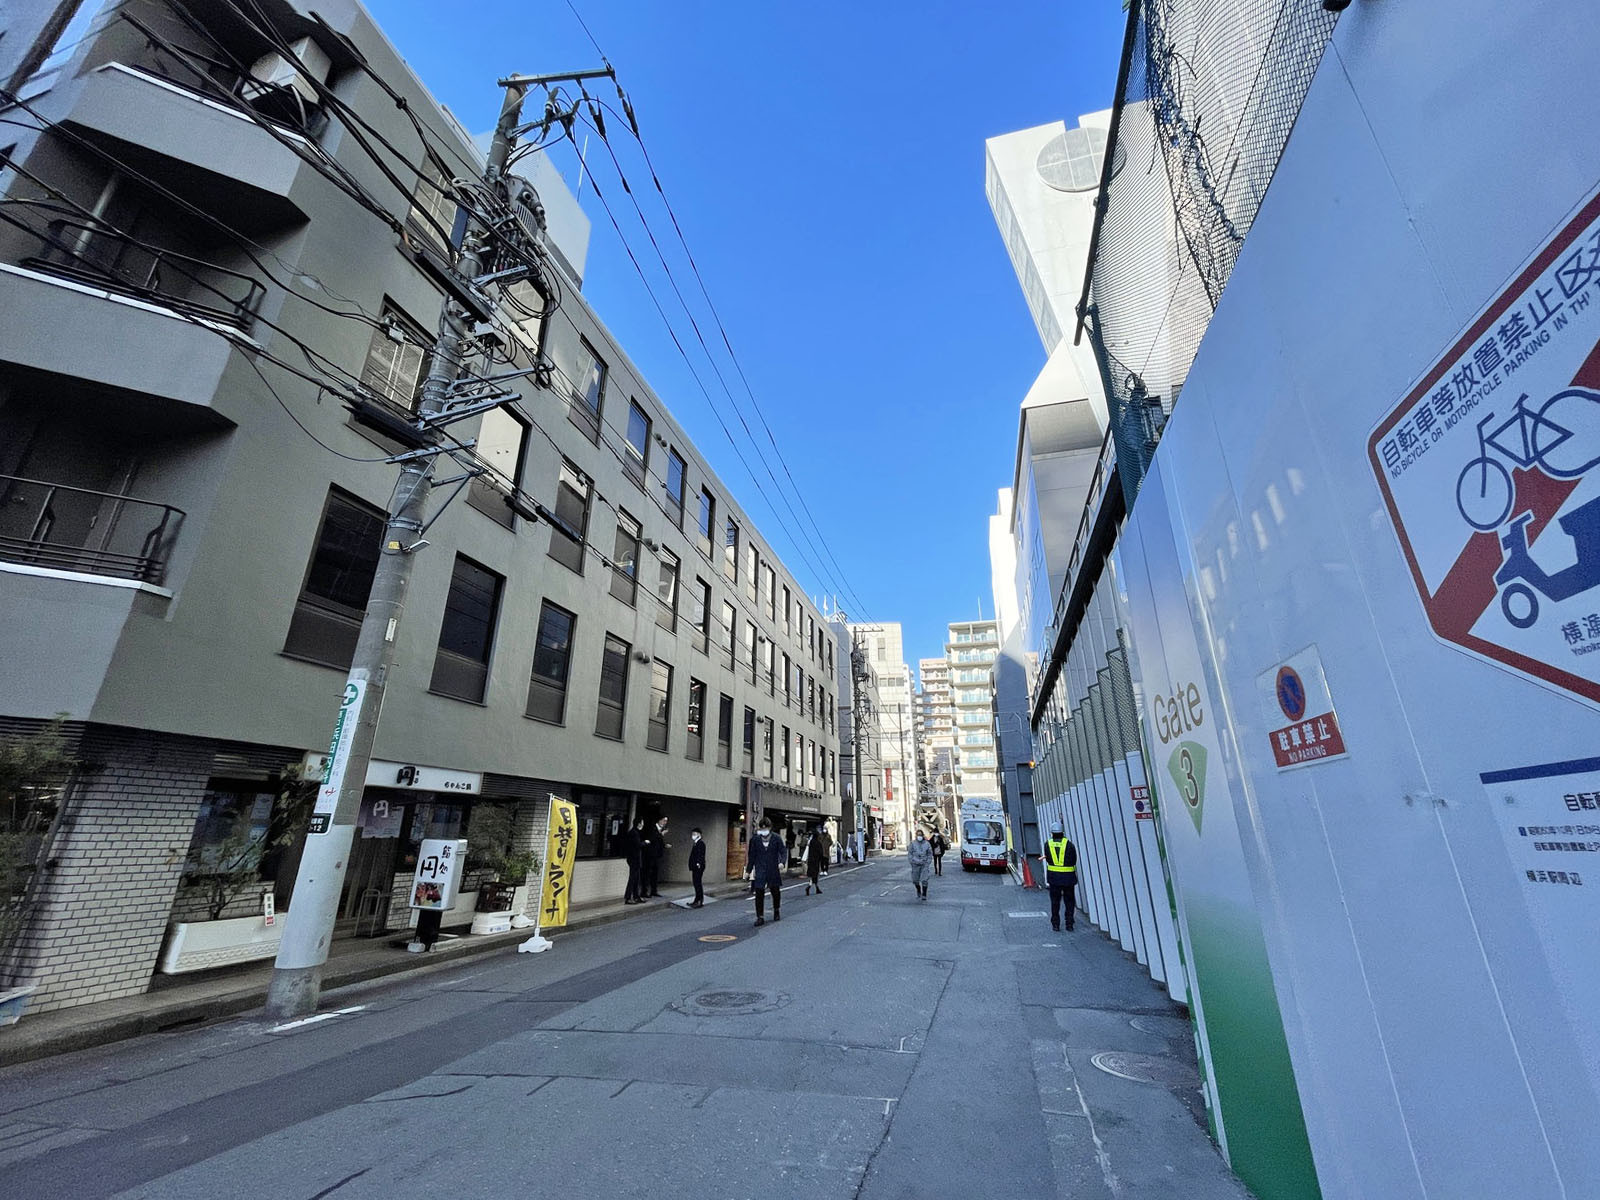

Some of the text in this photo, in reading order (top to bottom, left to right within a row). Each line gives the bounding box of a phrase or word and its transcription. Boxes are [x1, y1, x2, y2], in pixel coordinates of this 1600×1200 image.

[1391, 465, 1402, 479] NO
[1400, 442, 1430, 471] BICYCLE
[1431, 427, 1444, 442] OR
[1444, 373, 1502, 430] MOTORCYCLE
[1503, 330, 1550, 376] PARKING
[1553, 312, 1568, 331] IN
[1154, 682, 1203, 744] Gate
[1278, 718, 1331, 751] 駐車禁止
[1288, 744, 1327, 763] NO PARKING
[396, 766, 416, 786] 円
[1180, 750, 1199, 808] 3
[420, 855, 439, 879] 円
